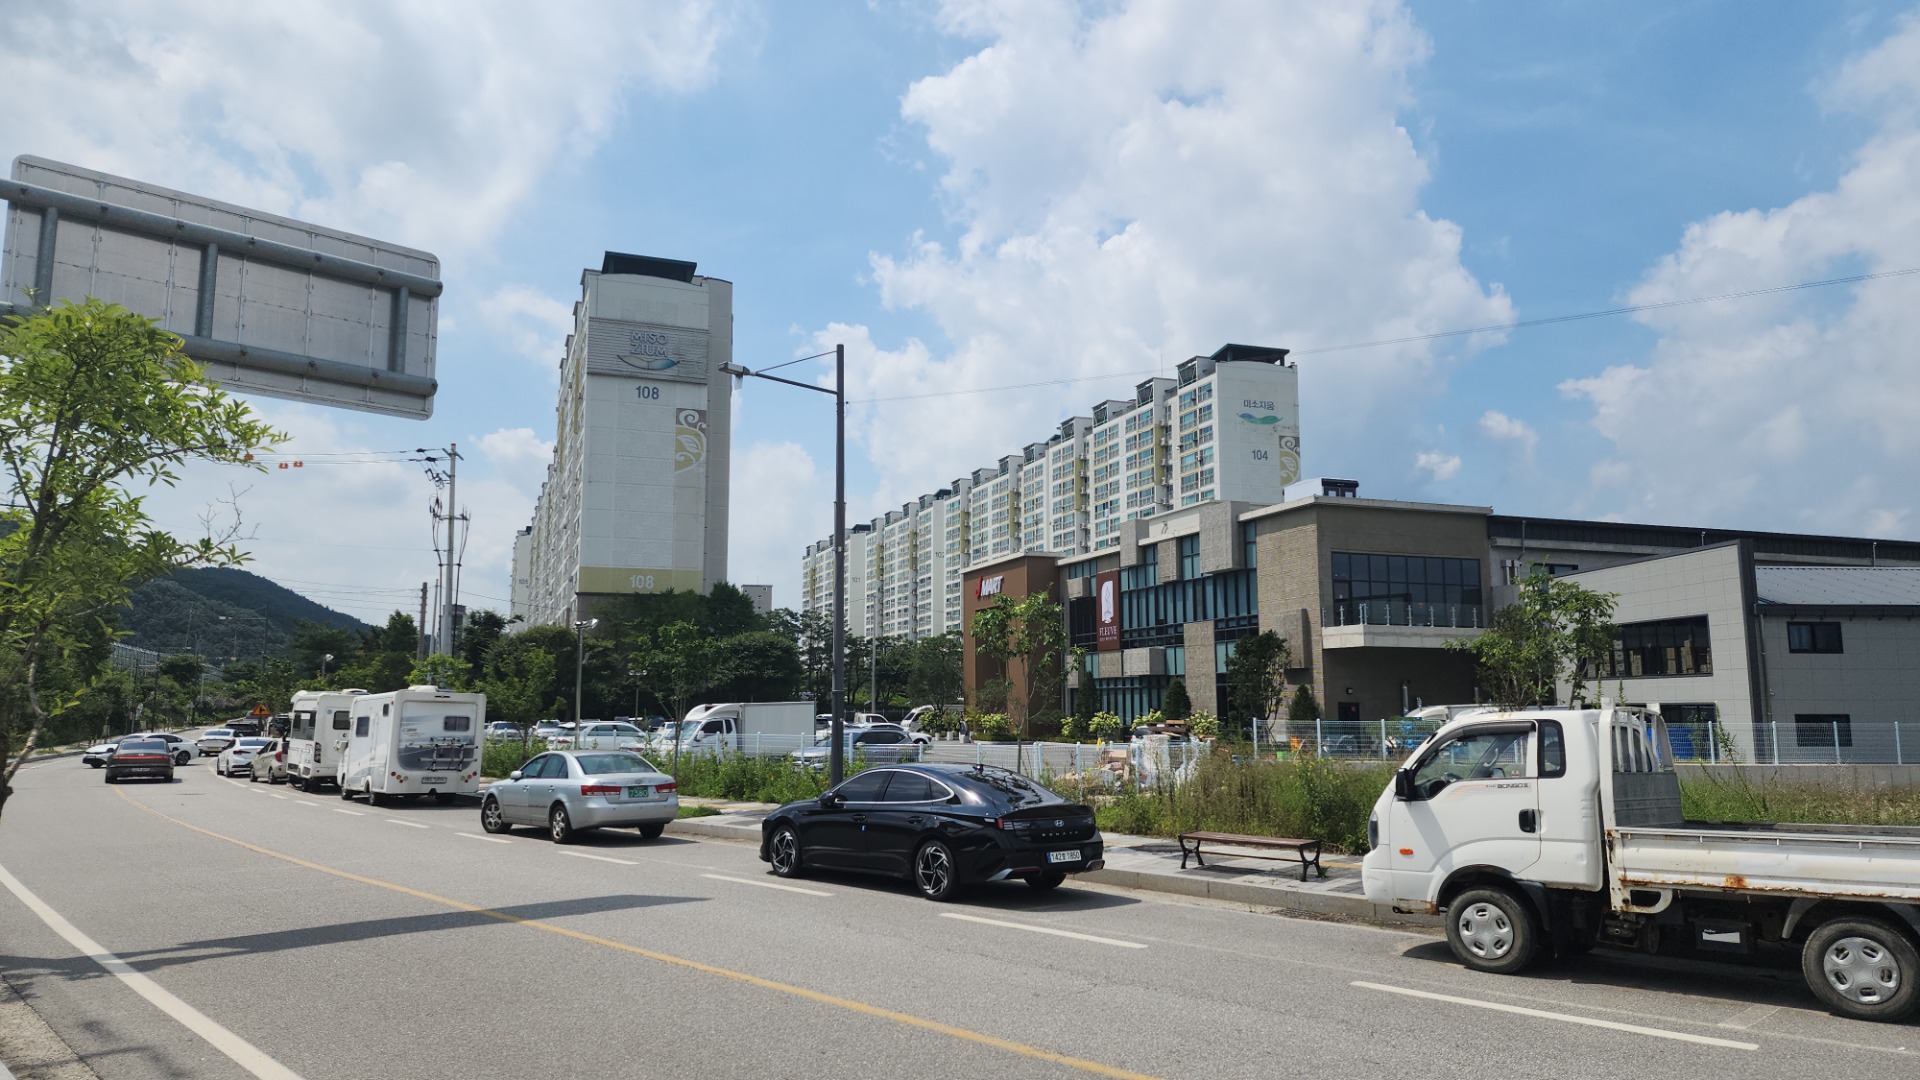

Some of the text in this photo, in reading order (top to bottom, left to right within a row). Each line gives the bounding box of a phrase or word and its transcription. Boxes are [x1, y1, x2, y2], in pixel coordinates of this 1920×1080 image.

[631, 331, 668, 345] MISO
[630, 342, 668, 358] ZIUM
[636, 385, 660, 400] 108
[1243, 399, 1275, 411] 미소지움
[1251, 449, 1269, 461] 104
[629, 575, 655, 589] 108
